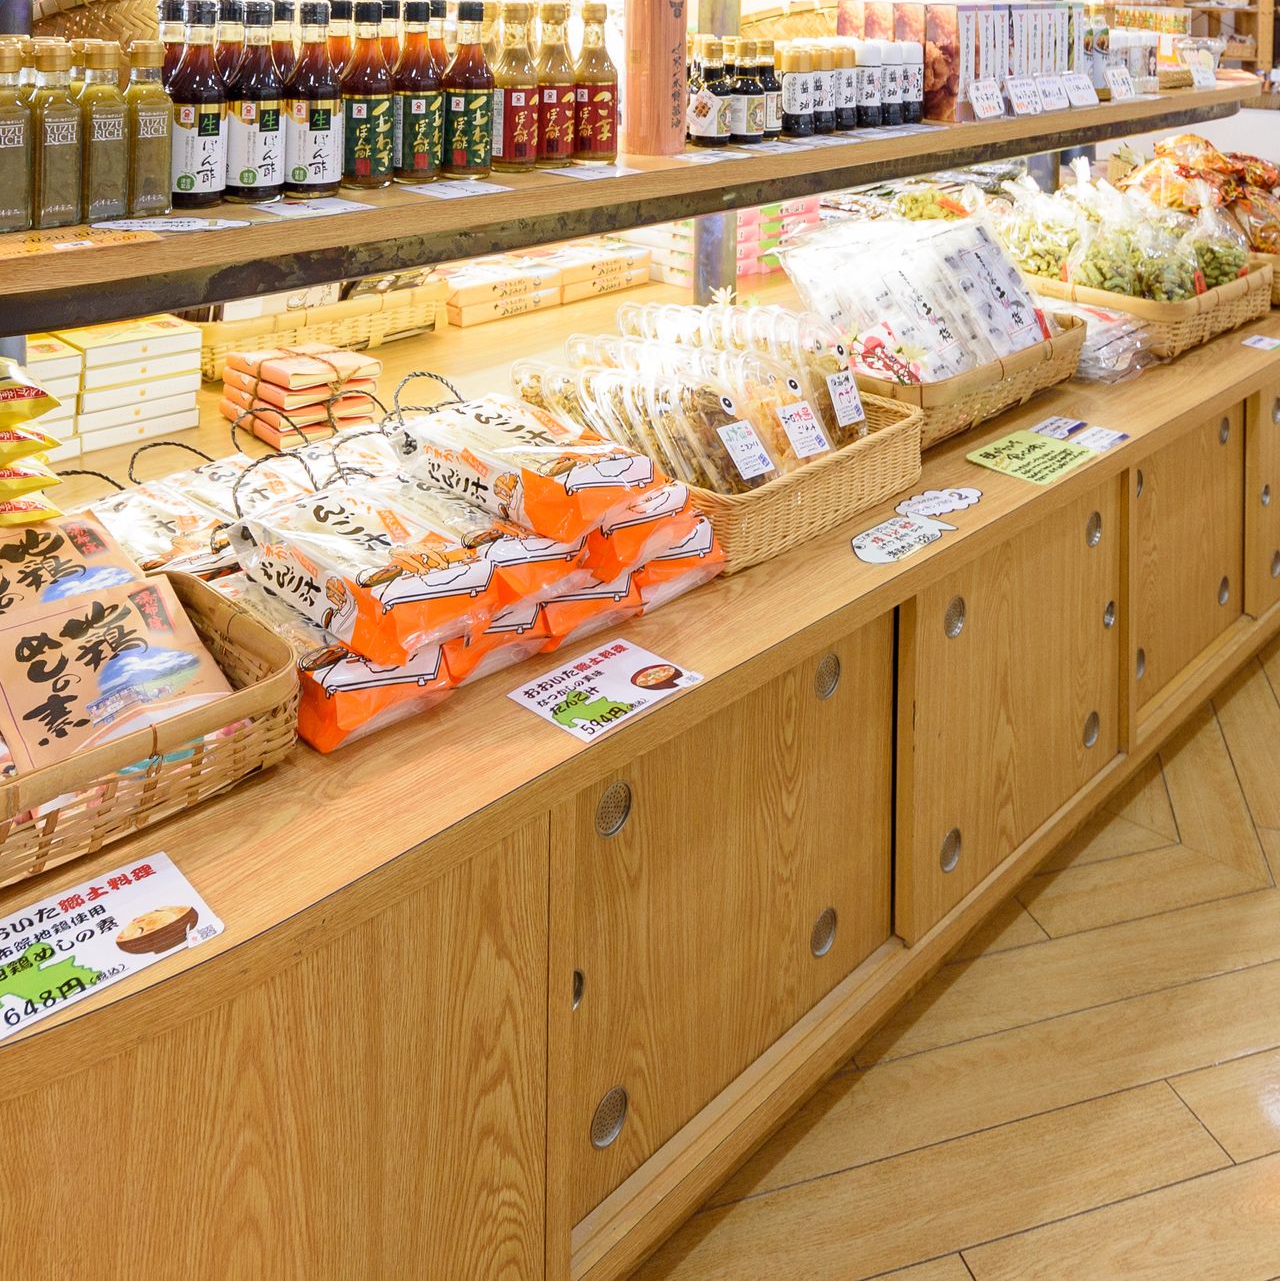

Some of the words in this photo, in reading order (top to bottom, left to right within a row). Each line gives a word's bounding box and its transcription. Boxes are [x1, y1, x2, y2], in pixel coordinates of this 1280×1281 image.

[45, 124, 77, 135] YUZU
[93, 119, 123, 131] YUZU
[94, 128, 122, 139] RICH
[139, 117, 168, 128] YUZU
[140, 125, 167, 136] RICH
[46, 132, 77, 143] RICH
[21, 233, 66, 244] YUZU
[74, 229, 114, 239] RICH
[131, 588, 169, 632] 湯布院
[59, 600, 151, 674] 地鶏
[523, 644, 630, 700] おおいた郷土料理
[14, 632, 91, 747] めしの素
[536, 669, 605, 708] なつかしの美味
[580, 705, 629, 736] 594円
[3, 975, 87, 1027] 648円
